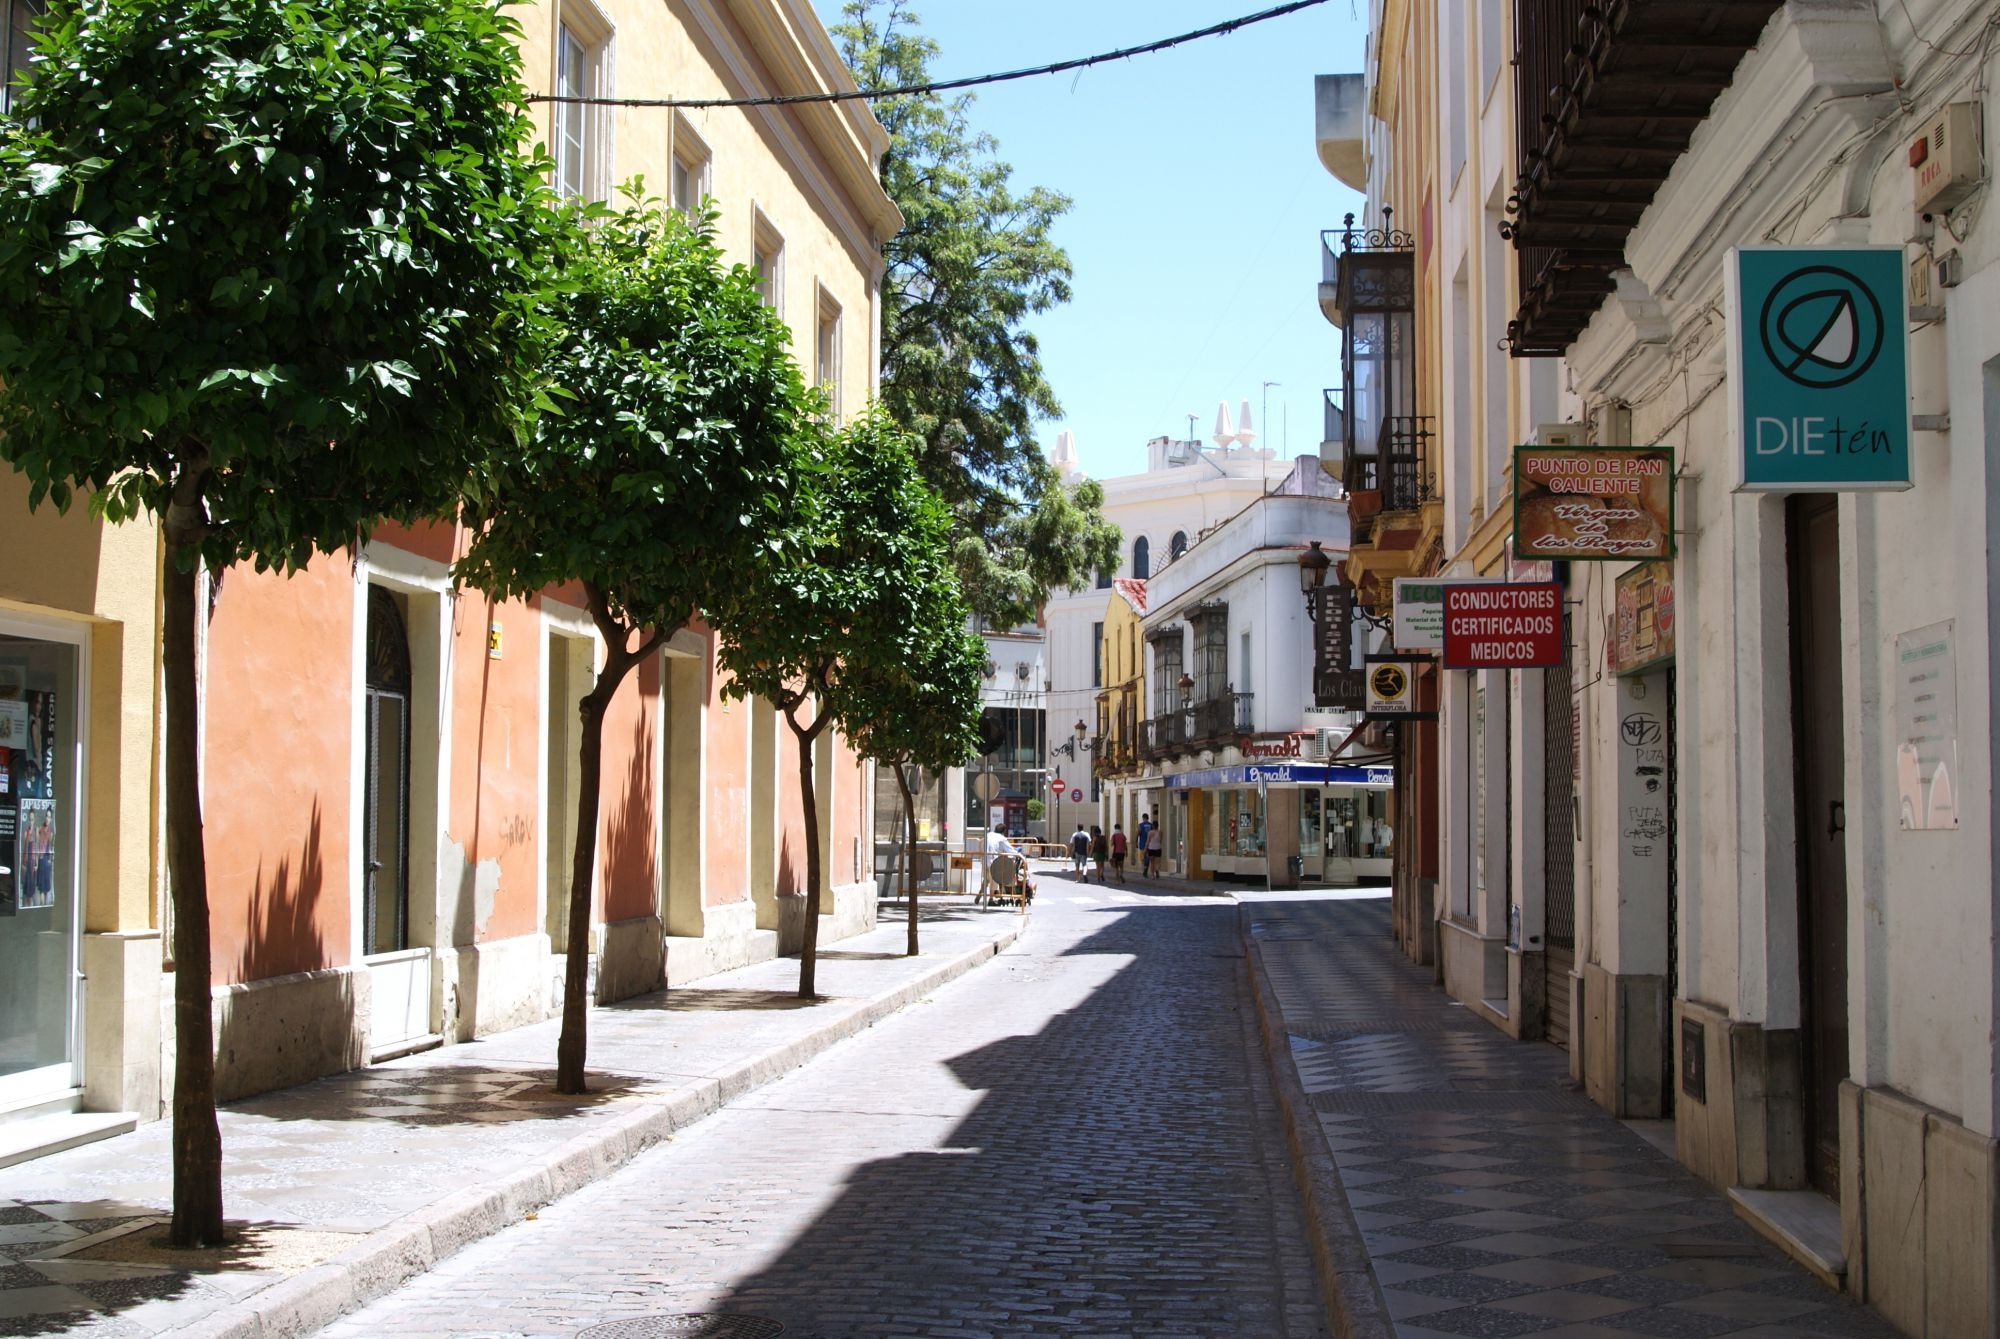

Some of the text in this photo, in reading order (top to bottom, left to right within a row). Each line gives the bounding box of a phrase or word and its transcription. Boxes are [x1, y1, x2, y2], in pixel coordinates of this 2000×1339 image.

[1756, 416, 1892, 455] DIEtén
[1527, 458, 1662, 475] PUNTO DE PAN
[1549, 477, 1640, 494] CALIENTE
[1555, 504, 1638, 521] Virgen
[1574, 523, 1607, 535] de
[1533, 535, 1656, 553] los Reyes
[1450, 590, 1555, 611] CONDUCTORES
[1325, 594, 1342, 673] FLORISTERIA
[1451, 616, 1554, 636] CERTIFICADOS
[1471, 641, 1535, 661] MEDICOS
[1318, 679, 1336, 697] Los
[45, 694, 56, 785] LANAS STOP
[1240, 734, 1302, 758] Donald
